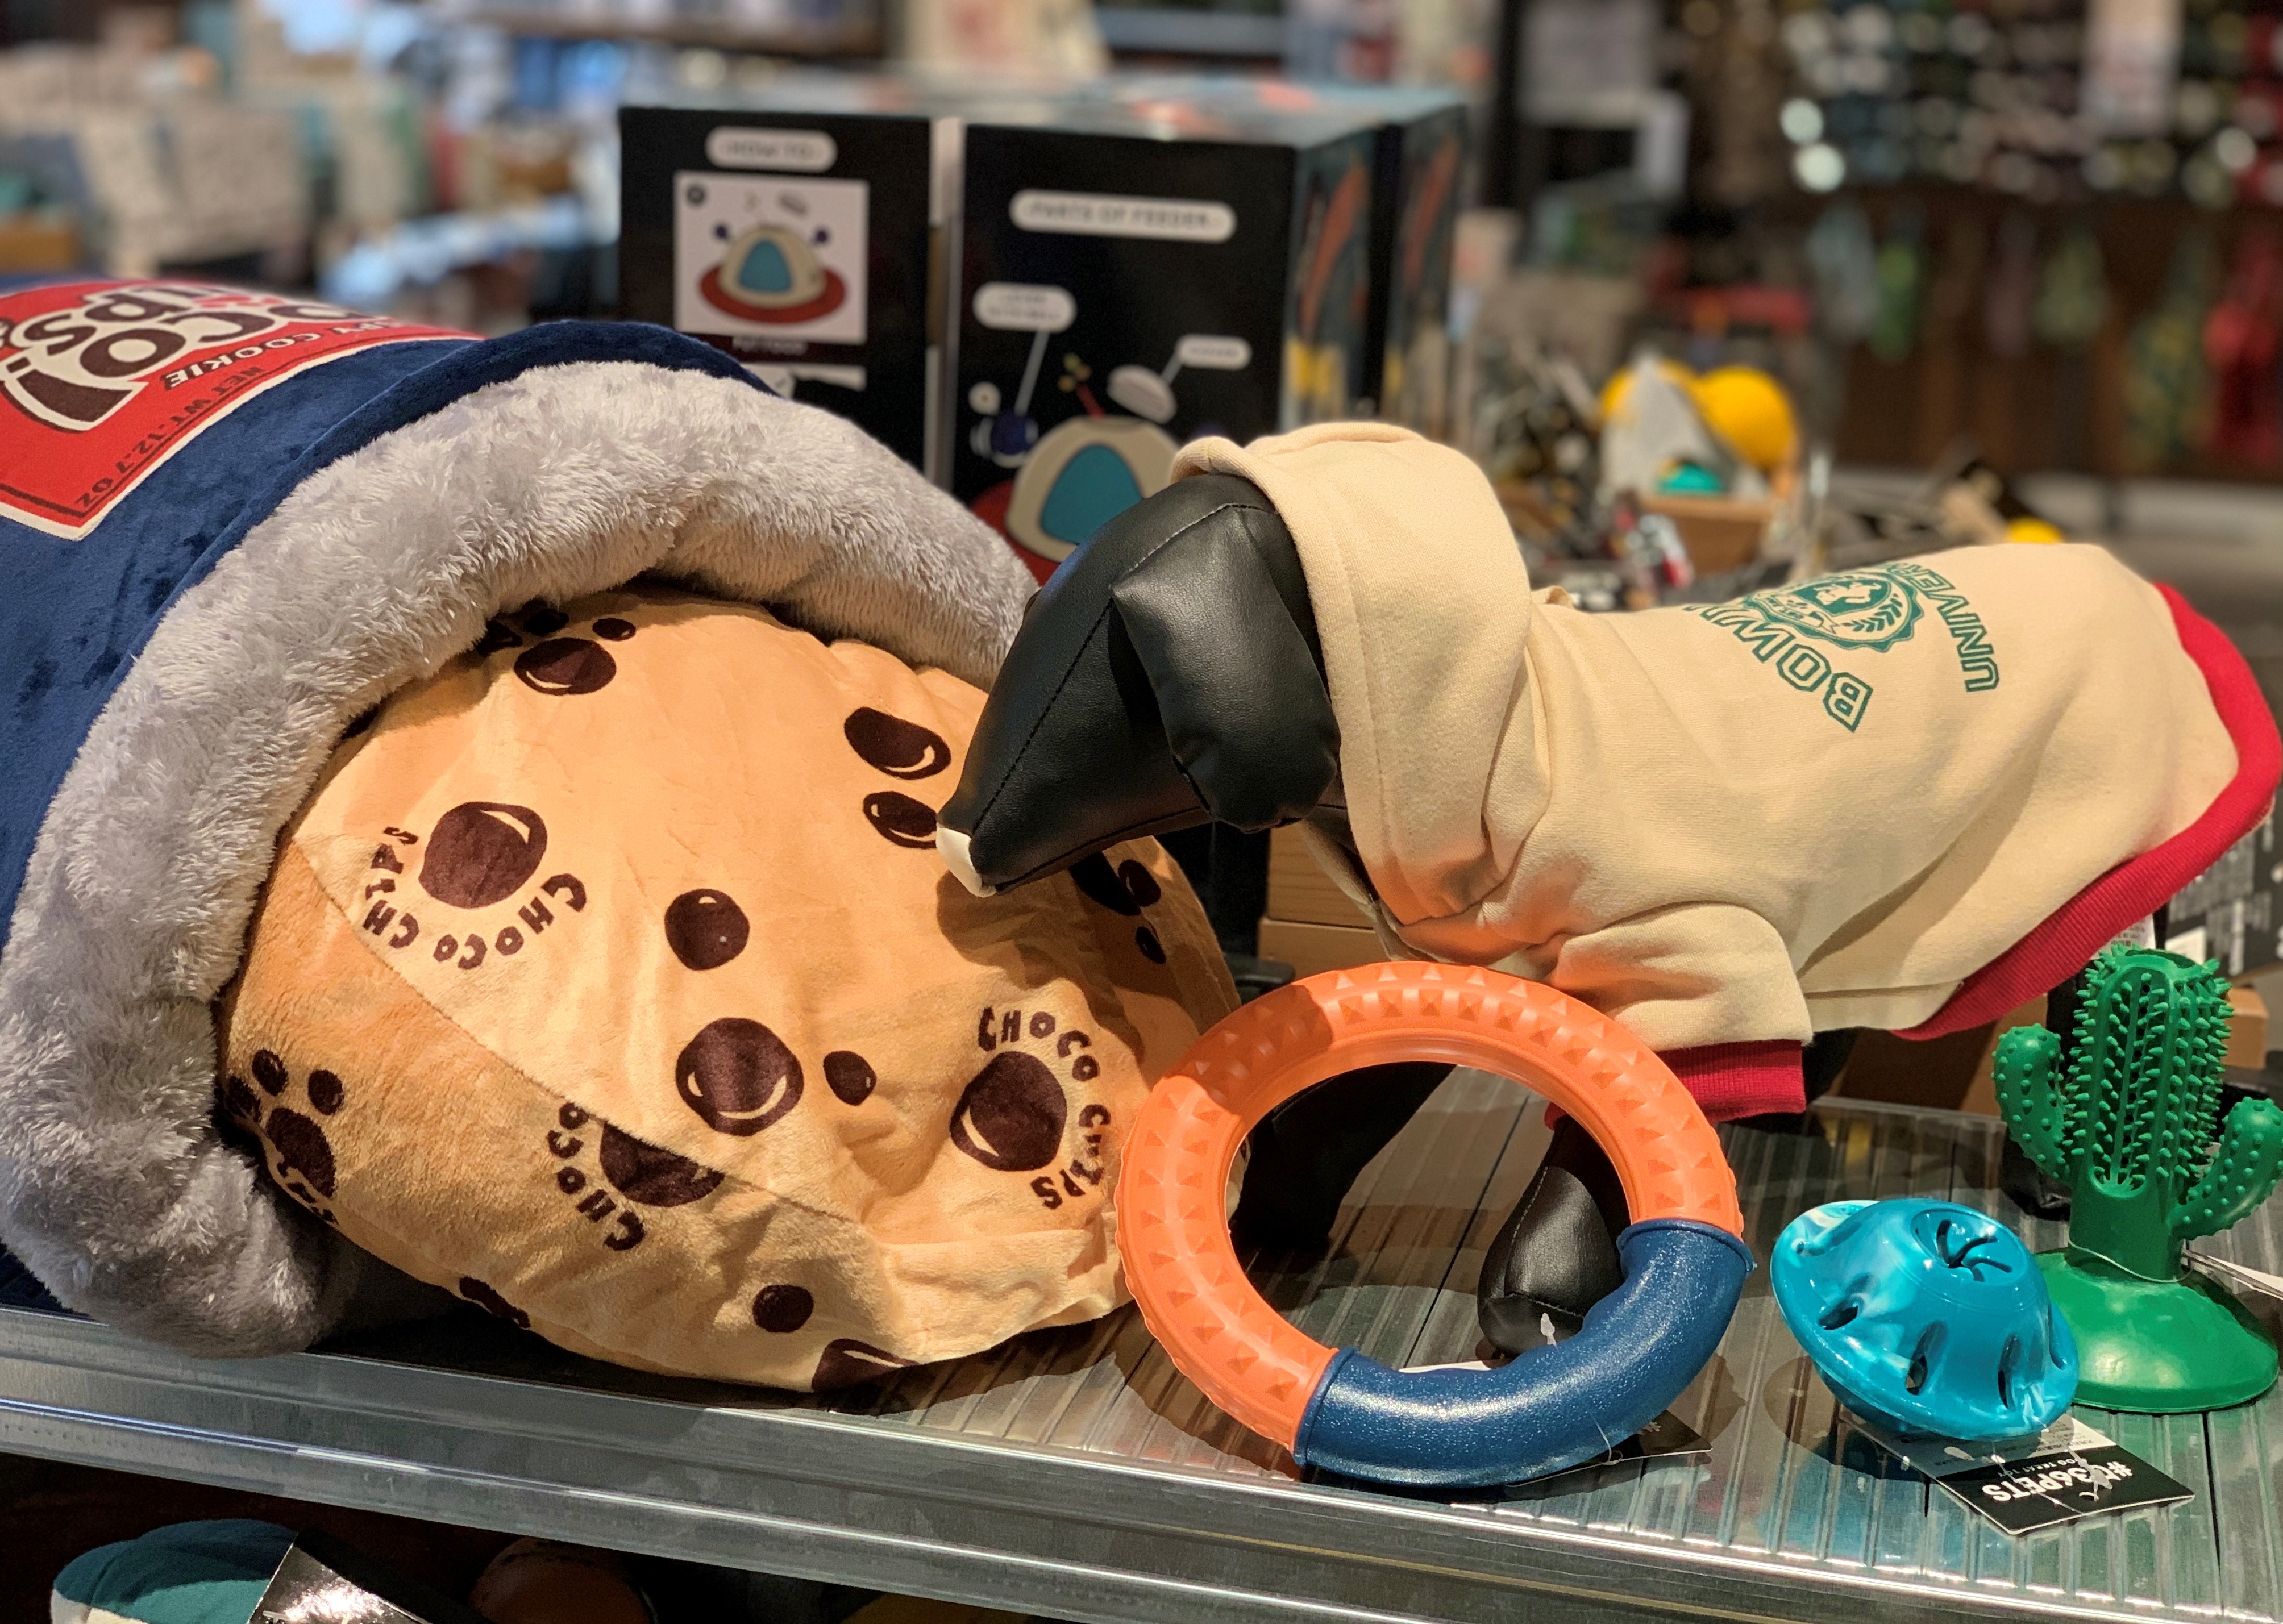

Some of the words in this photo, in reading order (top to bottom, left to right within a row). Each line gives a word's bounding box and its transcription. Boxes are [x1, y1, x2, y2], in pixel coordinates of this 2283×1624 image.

[164, 332, 322, 390] COOKIE
[211, 367, 264, 395] NET
[73, 477, 114, 507] OZ
[362, 827, 419, 949] CHIPS
[434, 873, 587, 970] CHOCO
[978, 1006, 1100, 1082] CHOCO
[547, 1101, 646, 1251] CHOCO
[2022, 1461, 2057, 1472] TREAT
